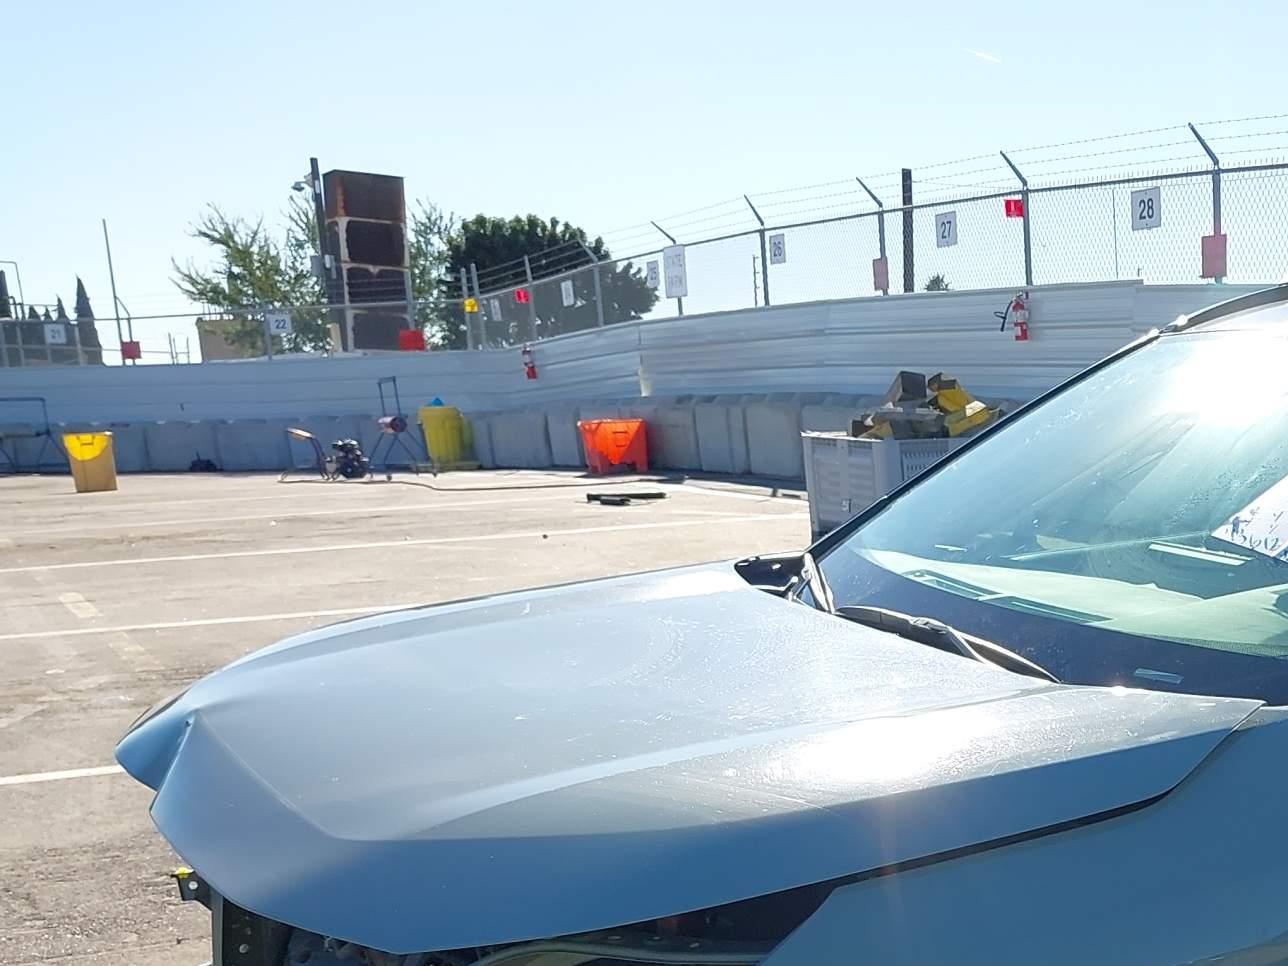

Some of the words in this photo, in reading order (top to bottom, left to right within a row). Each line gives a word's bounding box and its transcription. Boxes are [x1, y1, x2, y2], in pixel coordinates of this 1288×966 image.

[1138, 198, 1155, 221] 28
[940, 220, 953, 240] 27
[772, 240, 783, 257] 26
[274, 318, 288, 330] 22
